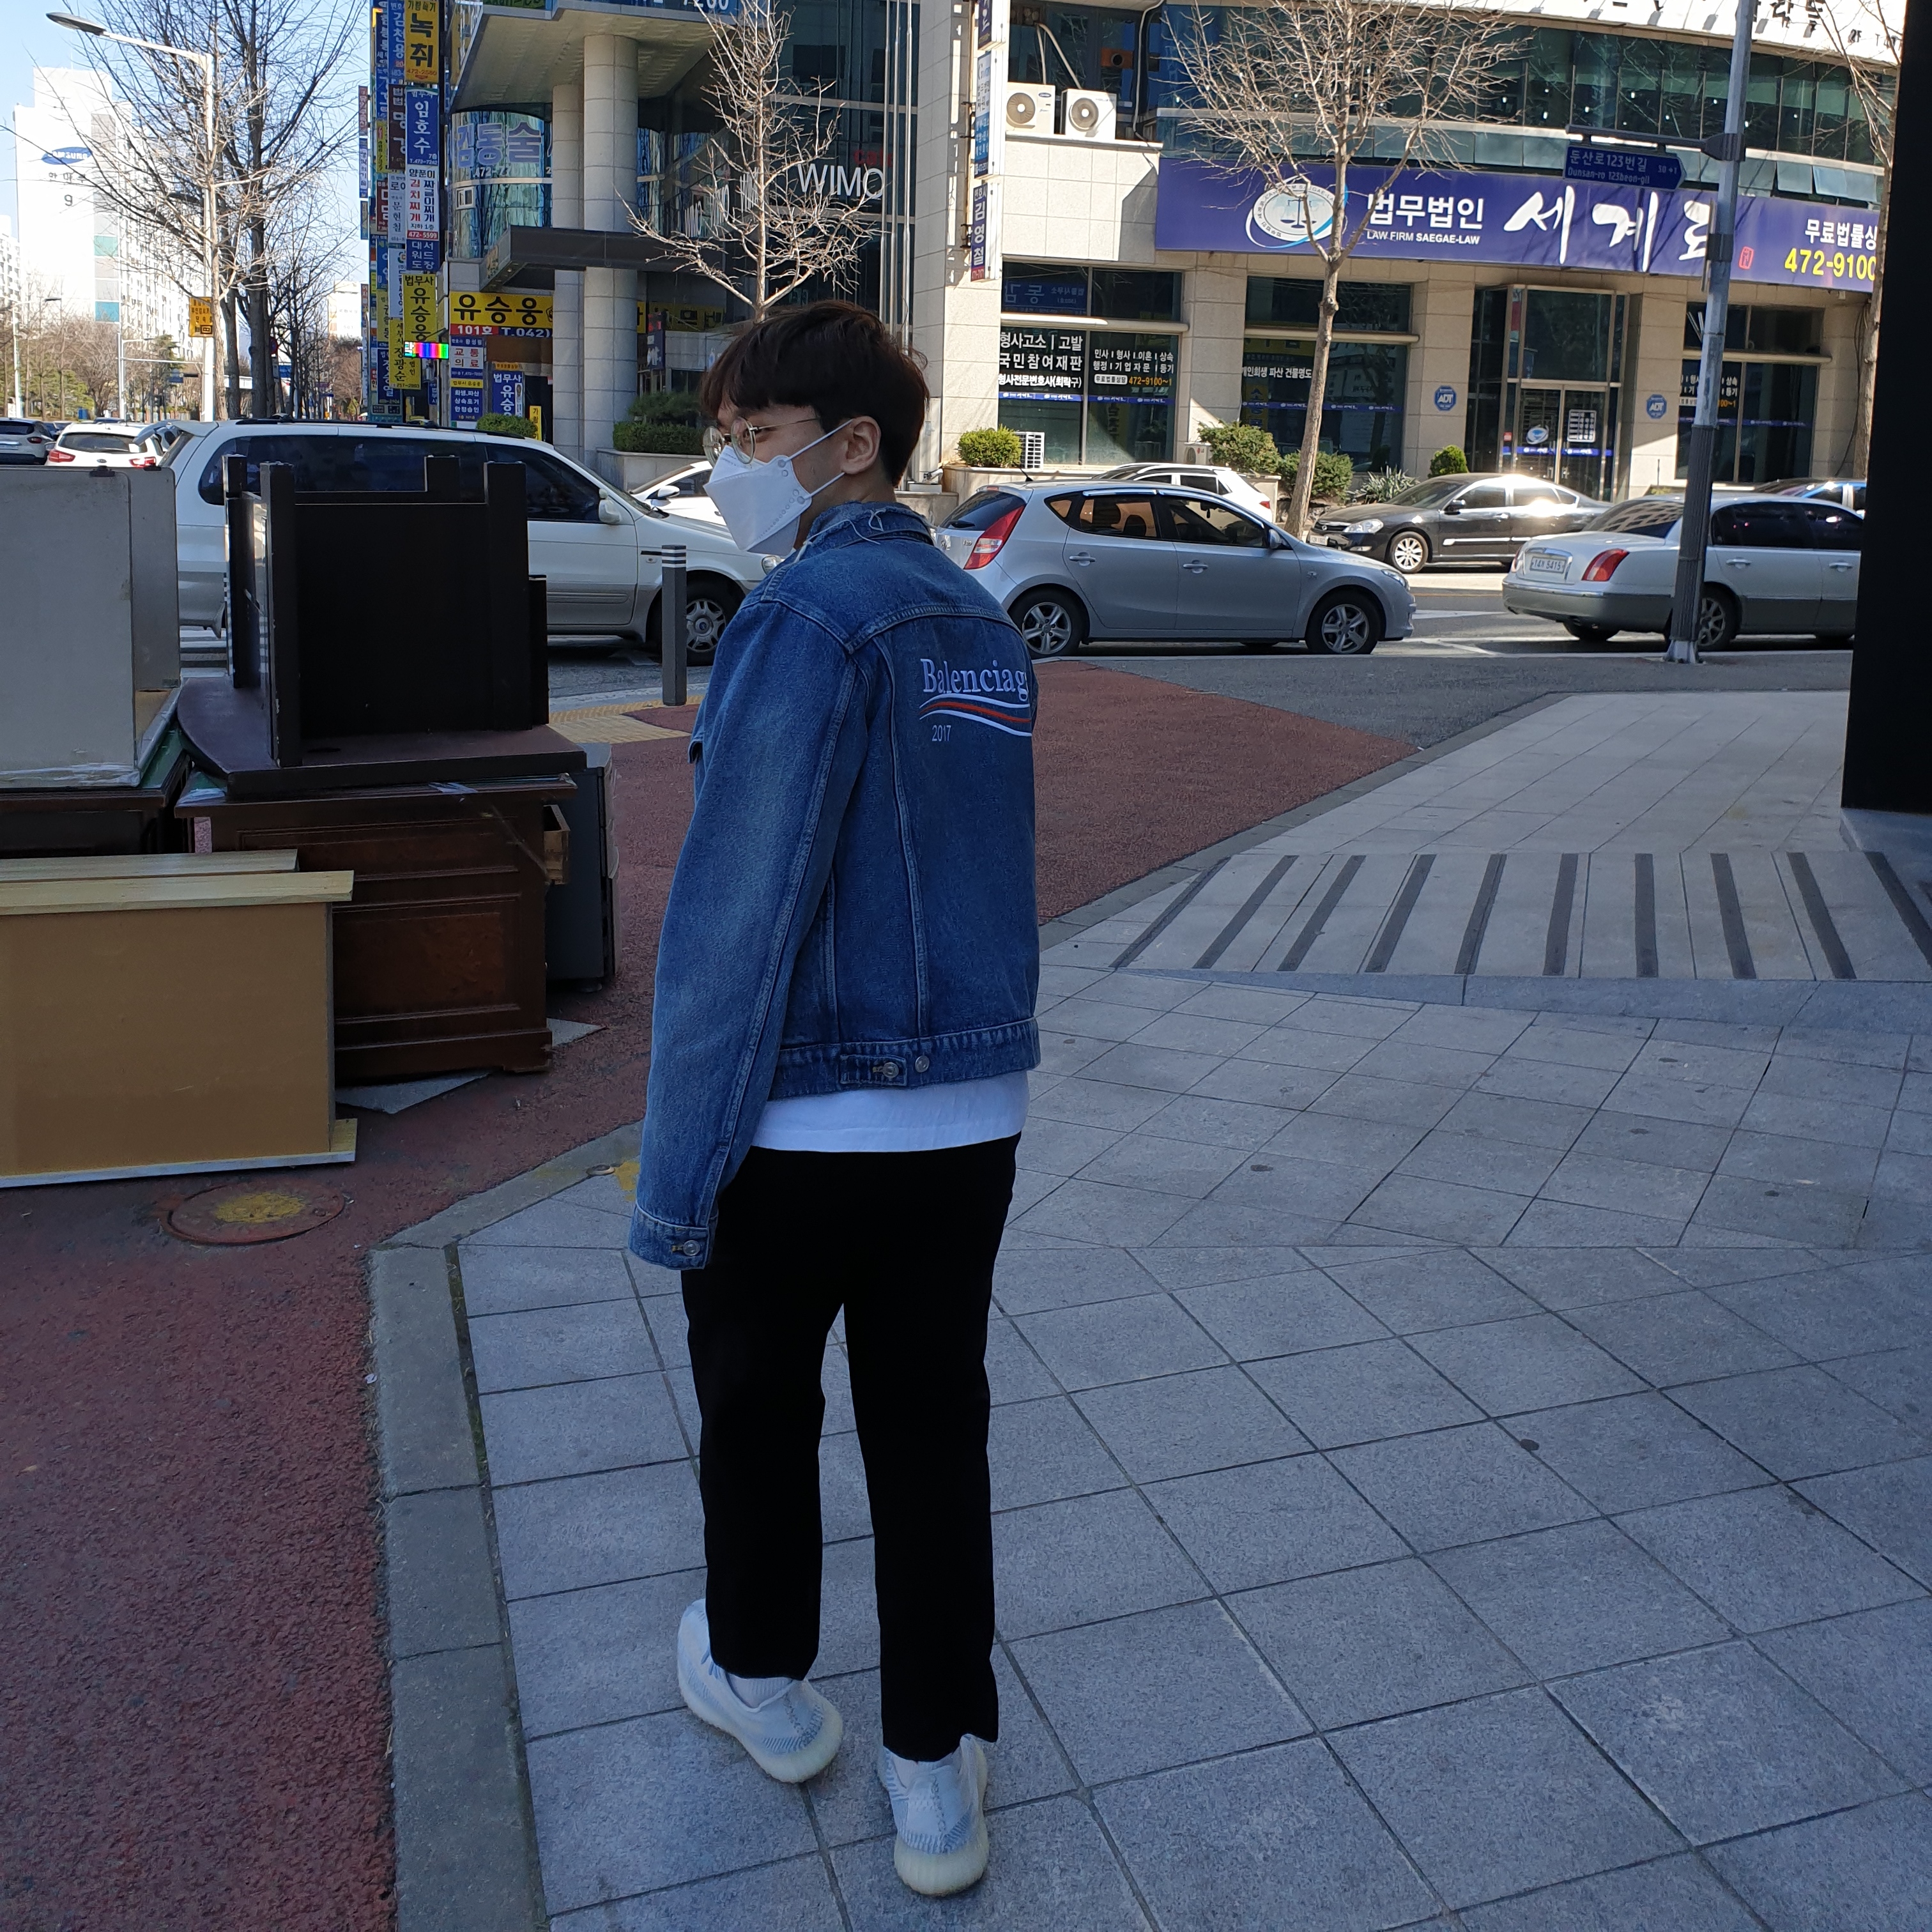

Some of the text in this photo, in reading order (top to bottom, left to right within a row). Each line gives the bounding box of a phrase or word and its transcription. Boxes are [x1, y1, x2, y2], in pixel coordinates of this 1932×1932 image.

[410, 13, 434, 68] 녹취
[413, 100, 431, 155] 임호수
[457, 121, 542, 169] 김동술
[1570, 150, 1646, 172] 둔산로123번길
[409, 168, 436, 178] 양푼이
[1568, 166, 1606, 180] Dunsan-ro
[797, 163, 885, 199] WIMO
[64, 194, 73, 206] 9
[410, 179, 421, 222] 김치찌개
[424, 180, 435, 222] 짜글이찌개
[1367, 193, 1484, 230] 법무법인
[1367, 230, 1480, 245] LAW FIRM SAEGAE-LAW
[411, 241, 434, 250] 대서
[411, 251, 434, 260] 워드
[411, 260, 434, 270] 도장
[1784, 247, 1876, 281] 472-9100
[405, 275, 434, 286] 법무사
[410, 288, 431, 341] 유승웅
[454, 294, 544, 326] 유승웅
[457, 325, 493, 335] 101호
[1000, 332, 1083, 351] 형사고소 고발
[454, 348, 479, 357] 교통
[1094, 349, 1174, 362] 민사 형사 이혼 상속
[454, 359, 479, 367] 의료
[999, 352, 1083, 371] 국민참여재판
[1093, 360, 1174, 374] 행정 기업자문 등기
[493, 373, 522, 383] 법무사
[1242, 365, 1312, 379] 개인회생 파산 건물명도
[1128, 376, 1172, 386] 472-9100~1
[1438, 394, 1453, 403] ADT
[1650, 402, 1664, 411] ADT
[1545, 560, 1561, 571] 5415
[921, 658, 1029, 702] Balenciag
[931, 724, 951, 742] 2017
